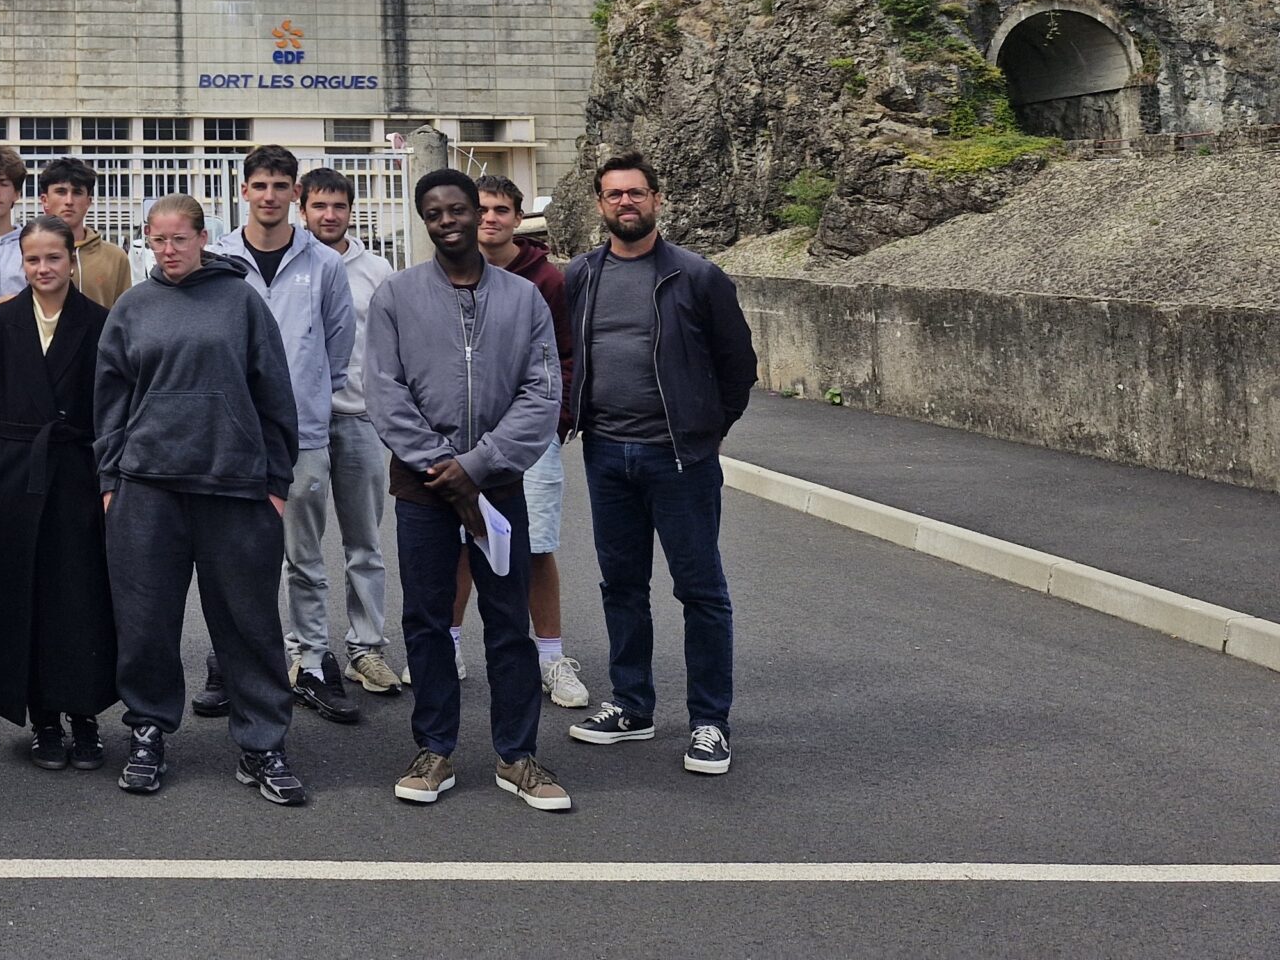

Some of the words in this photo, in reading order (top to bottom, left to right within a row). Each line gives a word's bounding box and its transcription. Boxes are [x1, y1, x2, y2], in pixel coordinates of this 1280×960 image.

[198, 74, 253, 89] BORT
[258, 74, 294, 89] LES
[300, 75, 378, 90] ORGUES
